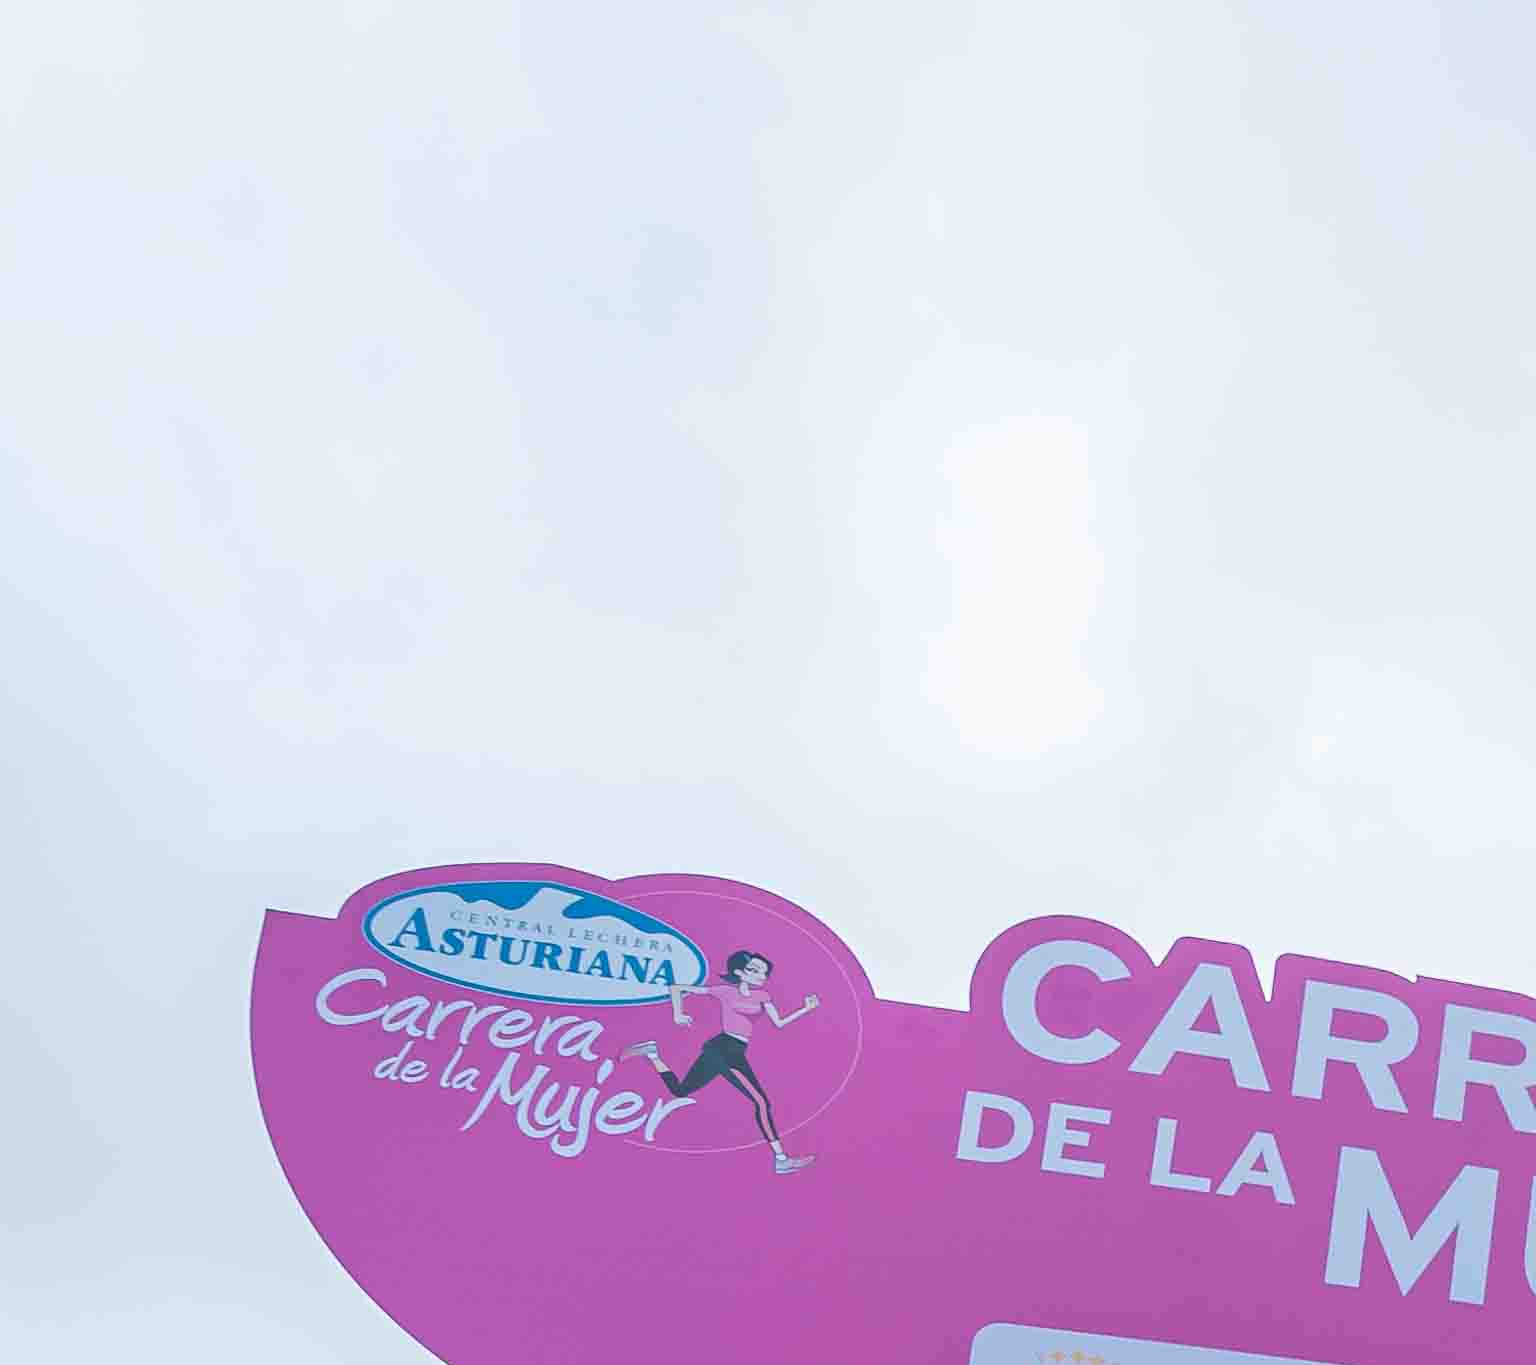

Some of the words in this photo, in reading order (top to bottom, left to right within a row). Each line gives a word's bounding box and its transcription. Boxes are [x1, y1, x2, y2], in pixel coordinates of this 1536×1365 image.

[387, 906, 677, 985] ASTURIANA
[450, 910, 556, 938] CENTRAL
[568, 928, 674, 954] LECHERA
[316, 969, 600, 1062] Carrera
[374, 1042, 429, 1082] de
[442, 1060, 478, 1092] la
[462, 1052, 697, 1157] Mujer
[956, 1090, 1112, 1178] DE
[1149, 1117, 1296, 1205] LA
